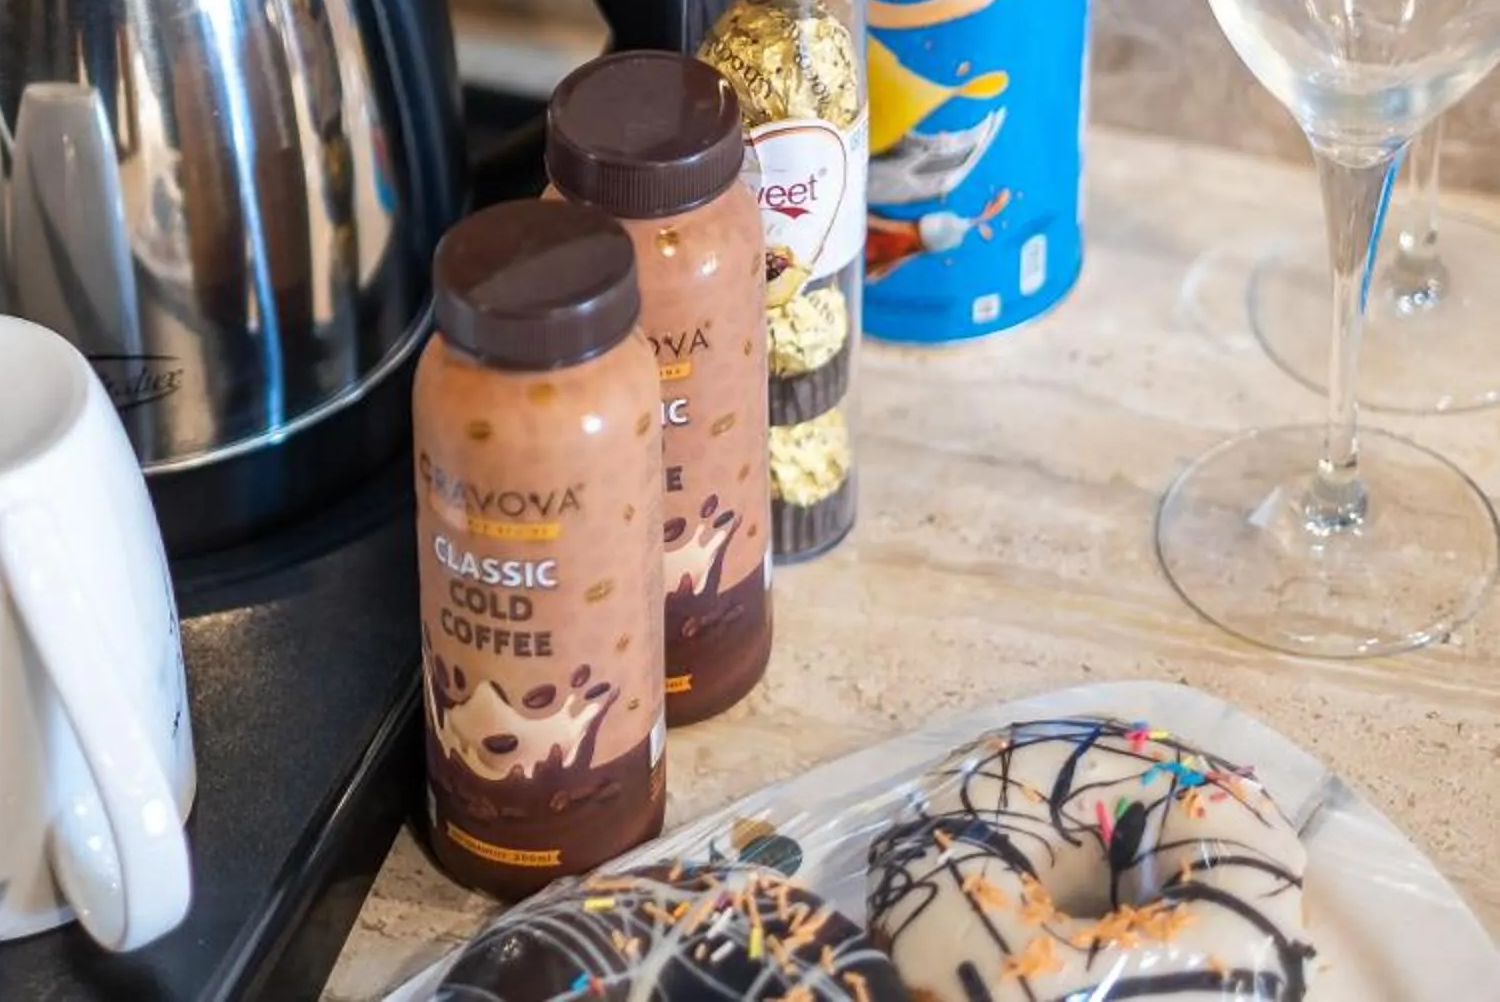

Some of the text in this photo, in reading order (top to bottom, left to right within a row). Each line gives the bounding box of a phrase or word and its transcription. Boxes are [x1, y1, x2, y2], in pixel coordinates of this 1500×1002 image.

[757, 174, 819, 207] eet
[433, 534, 559, 588] CLASSIC
[450, 579, 534, 623] COLD
[440, 607, 554, 658] COFFEE
